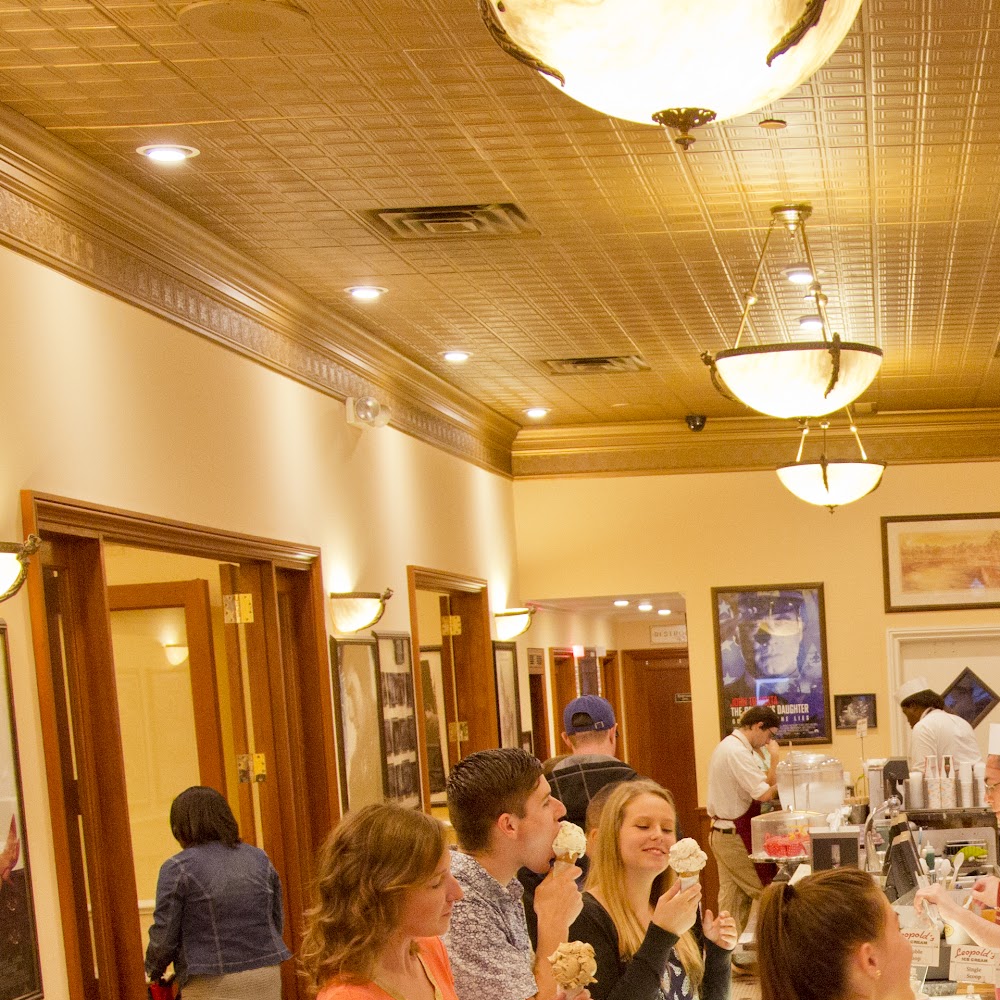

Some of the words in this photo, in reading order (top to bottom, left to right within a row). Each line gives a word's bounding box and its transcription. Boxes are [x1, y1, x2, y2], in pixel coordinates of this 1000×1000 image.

[777, 703, 809, 714] DAUGHTER
[902, 931, 935, 942] opold's
[955, 947, 995, 960] Leopold's
